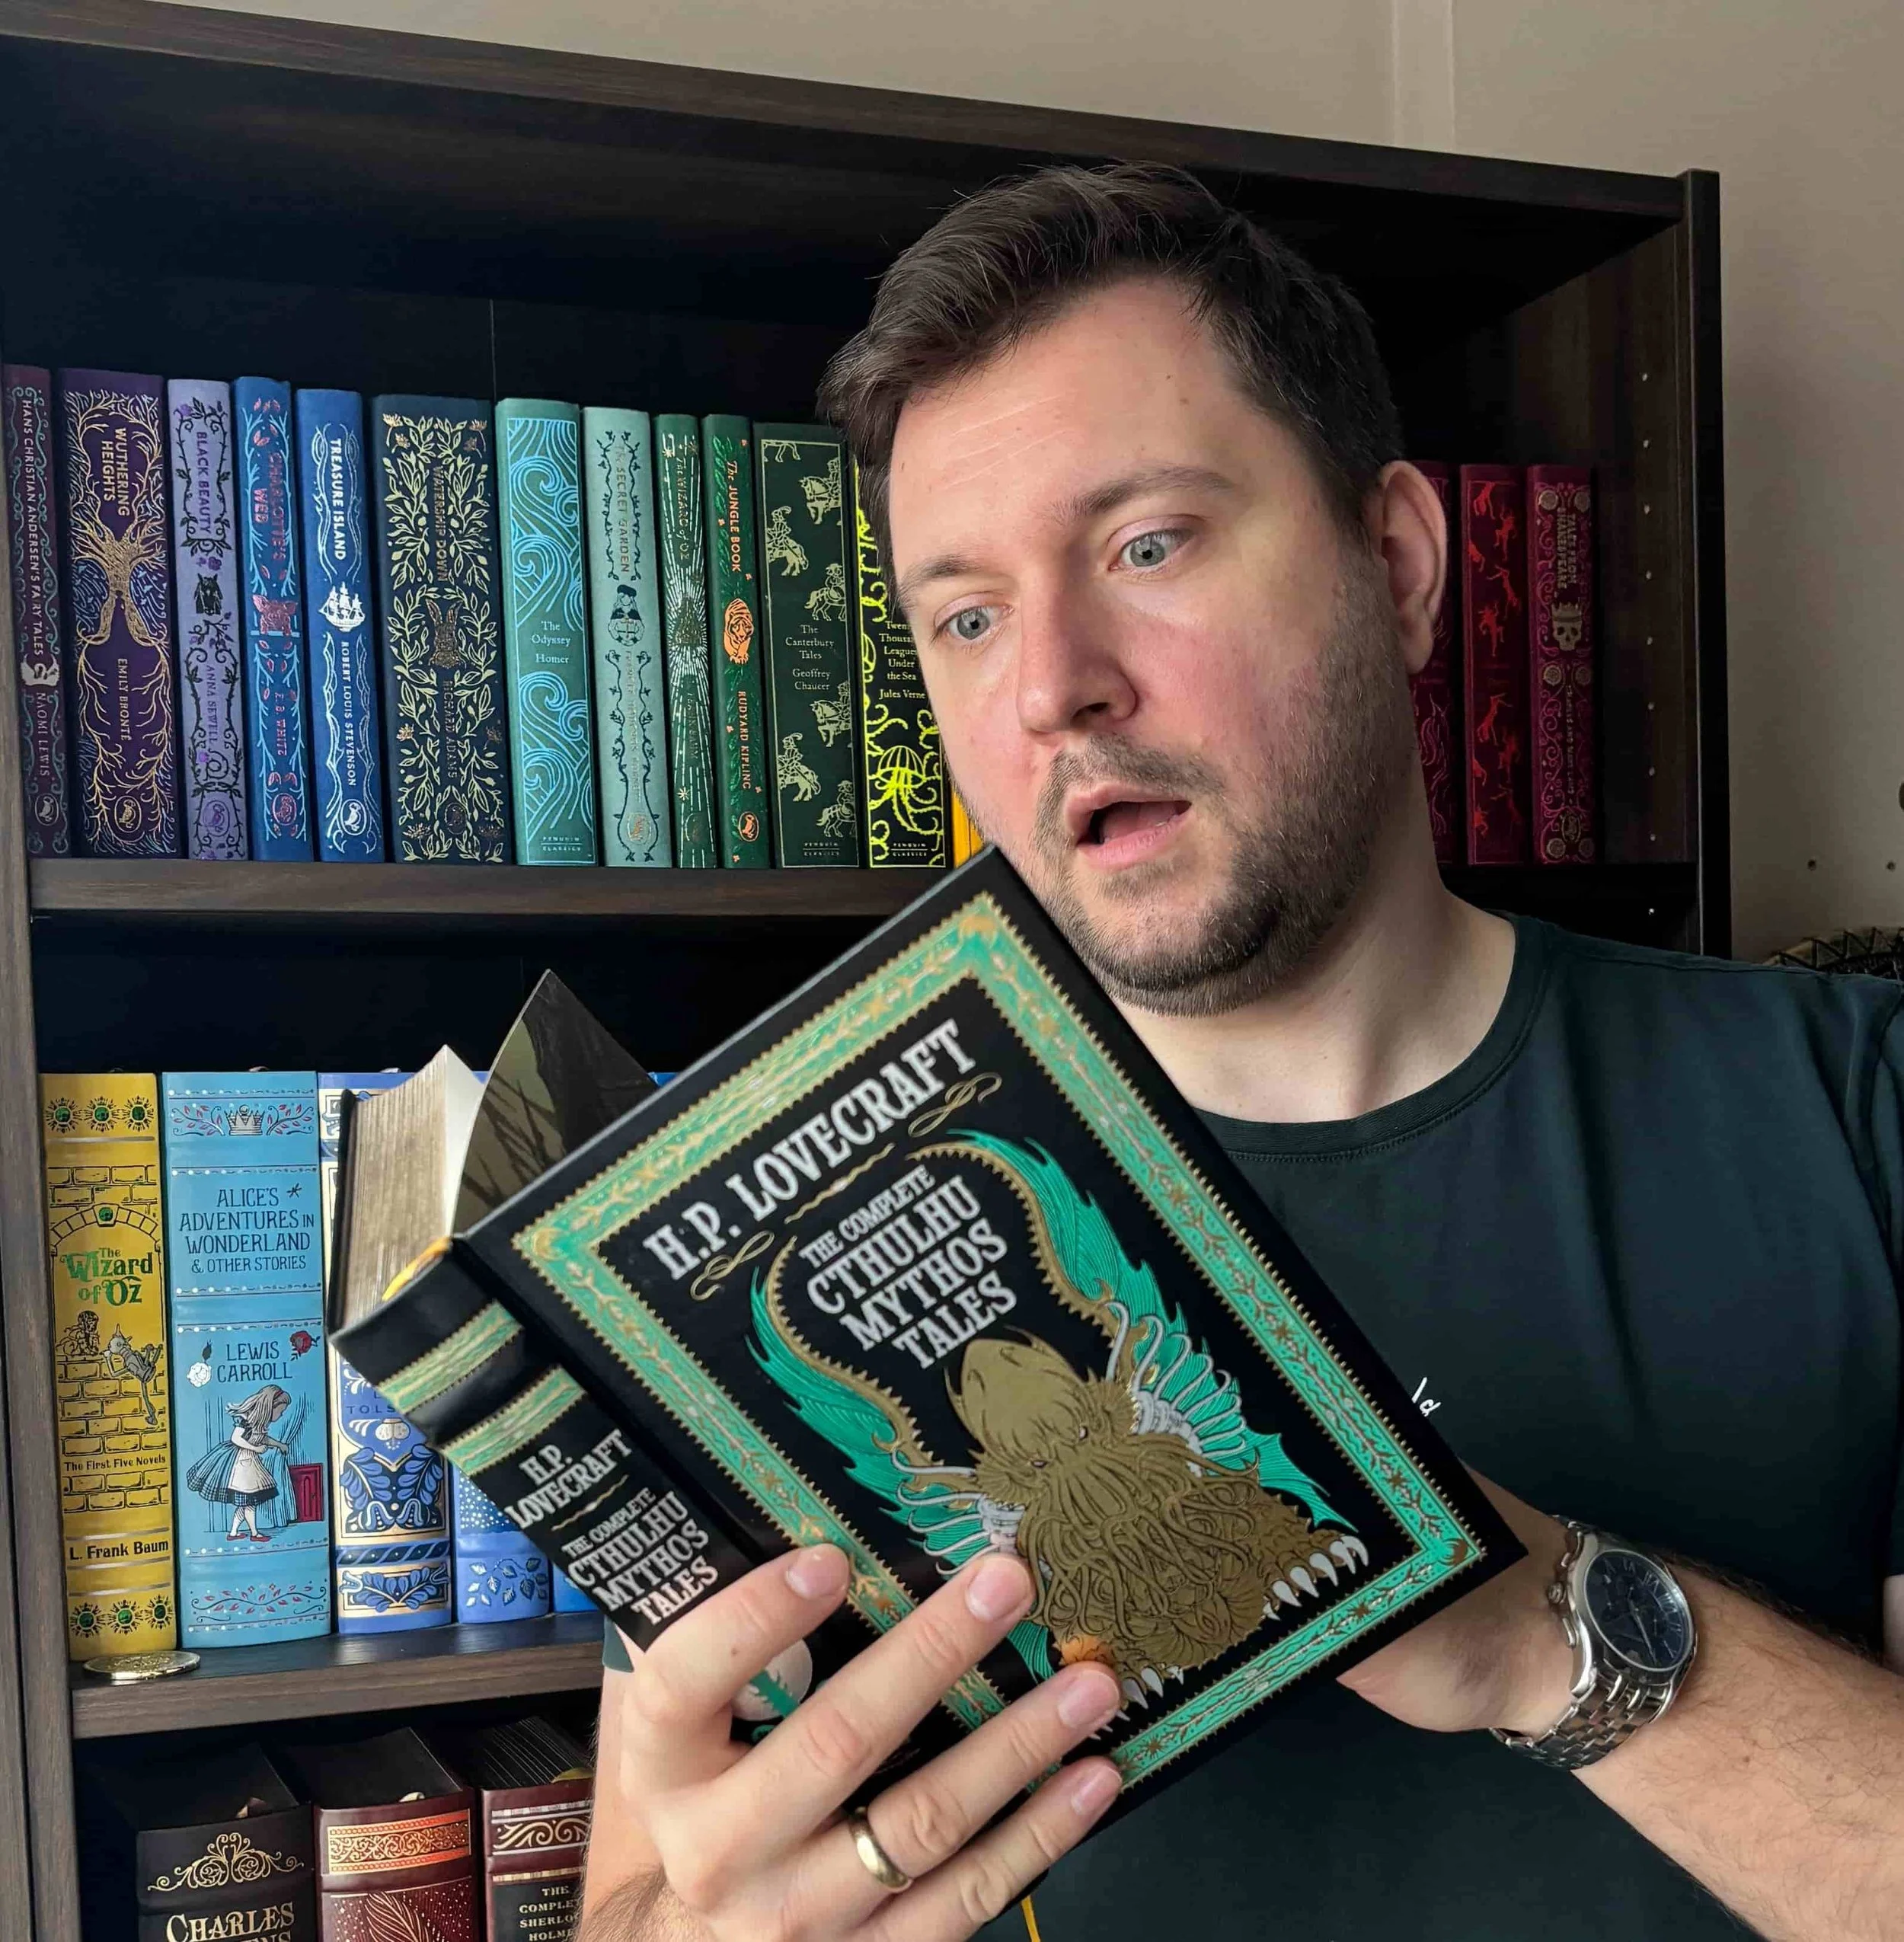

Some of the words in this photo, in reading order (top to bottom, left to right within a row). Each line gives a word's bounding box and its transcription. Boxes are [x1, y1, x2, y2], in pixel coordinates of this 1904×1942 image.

[22, 400, 34, 433] HANS
[24, 437, 37, 502] CHRISTIAN
[101, 440, 116, 502] HEIGHTS
[114, 428, 130, 516] WUTHERING
[196, 431, 209, 478] BLACK
[727, 460, 738, 481] The
[330, 438, 343, 507] TREASURE
[616, 467, 628, 513] SECRET
[198, 481, 212, 534] BEAUTY
[254, 487, 269, 524] WEB
[433, 465, 446, 537] WATERSHIP
[729, 484, 740, 533] JUNGLE
[27, 506, 40, 586] ANDERSEN'S
[333, 511, 347, 561] ISLAND
[618, 519, 631, 573] GARDEN
[436, 540, 449, 582] DOWN
[730, 536, 742, 573] BOOK
[30, 588, 43, 620] FARY
[33, 621, 44, 656] TALES
[531, 634, 571, 647] Odyssey
[541, 621, 561, 631] The
[785, 637, 835, 649] Canterbury
[800, 624, 819, 634] The
[878, 633, 913, 643] Thousa
[884, 621, 910, 630] Twen
[340, 641, 352, 682] ROBERT
[535, 653, 569, 663] Homer
[799, 650, 823, 660] Tales
[888, 659, 915, 668] Under
[117, 658, 129, 692] EMILY
[206, 665, 216, 697] ANNA
[792, 669, 831, 679] Geoffrey
[794, 681, 830, 690] Chaucer
[887, 672, 901, 680] the
[902, 672, 916, 680] Sea
[343, 686, 353, 719] LOUIS
[879, 689, 901, 700] Jules
[903, 689, 926, 699] Verne
[36, 692, 48, 734] NAOMI
[206, 700, 219, 744] SEWELL
[737, 691, 749, 741] RUDYARD
[39, 739, 50, 777] LEWIS
[344, 723, 357, 786] STEVENSON
[724, 1017, 976, 1222] LOVECRAFT
[216, 1187, 280, 1208] ALICE'S
[179, 1209, 299, 1231] ADVENTURES
[302, 1214, 315, 1228] IN
[798, 1229, 845, 1269] THE
[839, 1164, 936, 1242] COMPLETE
[99, 1247, 122, 1258] The
[185, 1231, 311, 1254] WONDERLAND
[807, 1174, 981, 1314] CTHULHU
[60, 1251, 153, 1282] Wizard
[191, 1258, 204, 1273] &
[207, 1257, 251, 1273] OTHER
[254, 1254, 306, 1272] STORIES
[78, 1284, 102, 1305] of
[101, 1275, 142, 1306] Oz
[839, 1218, 1008, 1352] MYTHOS
[891, 1270, 1017, 1369] TALES
[226, 1340, 280, 1361] LEWIS
[217, 1362, 292, 1383] CARROLL
[347, 1405, 396, 1414] TOLS
[64, 1461, 83, 1471] The
[86, 1461, 111, 1471] First
[113, 1458, 133, 1468] Five
[136, 1454, 166, 1465] Novels
[504, 1428, 632, 1529] LOVECRAFT
[519, 1444, 573, 1486] H.P.
[561, 1534, 594, 1559] THE
[589, 1487, 656, 1544] COMPLETE
[567, 1490, 688, 1586] CTHULHU
[69, 1547, 83, 1560] L.
[87, 1543, 129, 1559] Frank
[133, 1541, 168, 1554] Baum
[593, 1518, 709, 1612] MYTHOS
[631, 1555, 719, 1626] TALES
[541, 1885, 570, 1896] THE
[166, 1902, 296, 1942] CHARLES
[529, 1928, 574, 1941] HOLME
